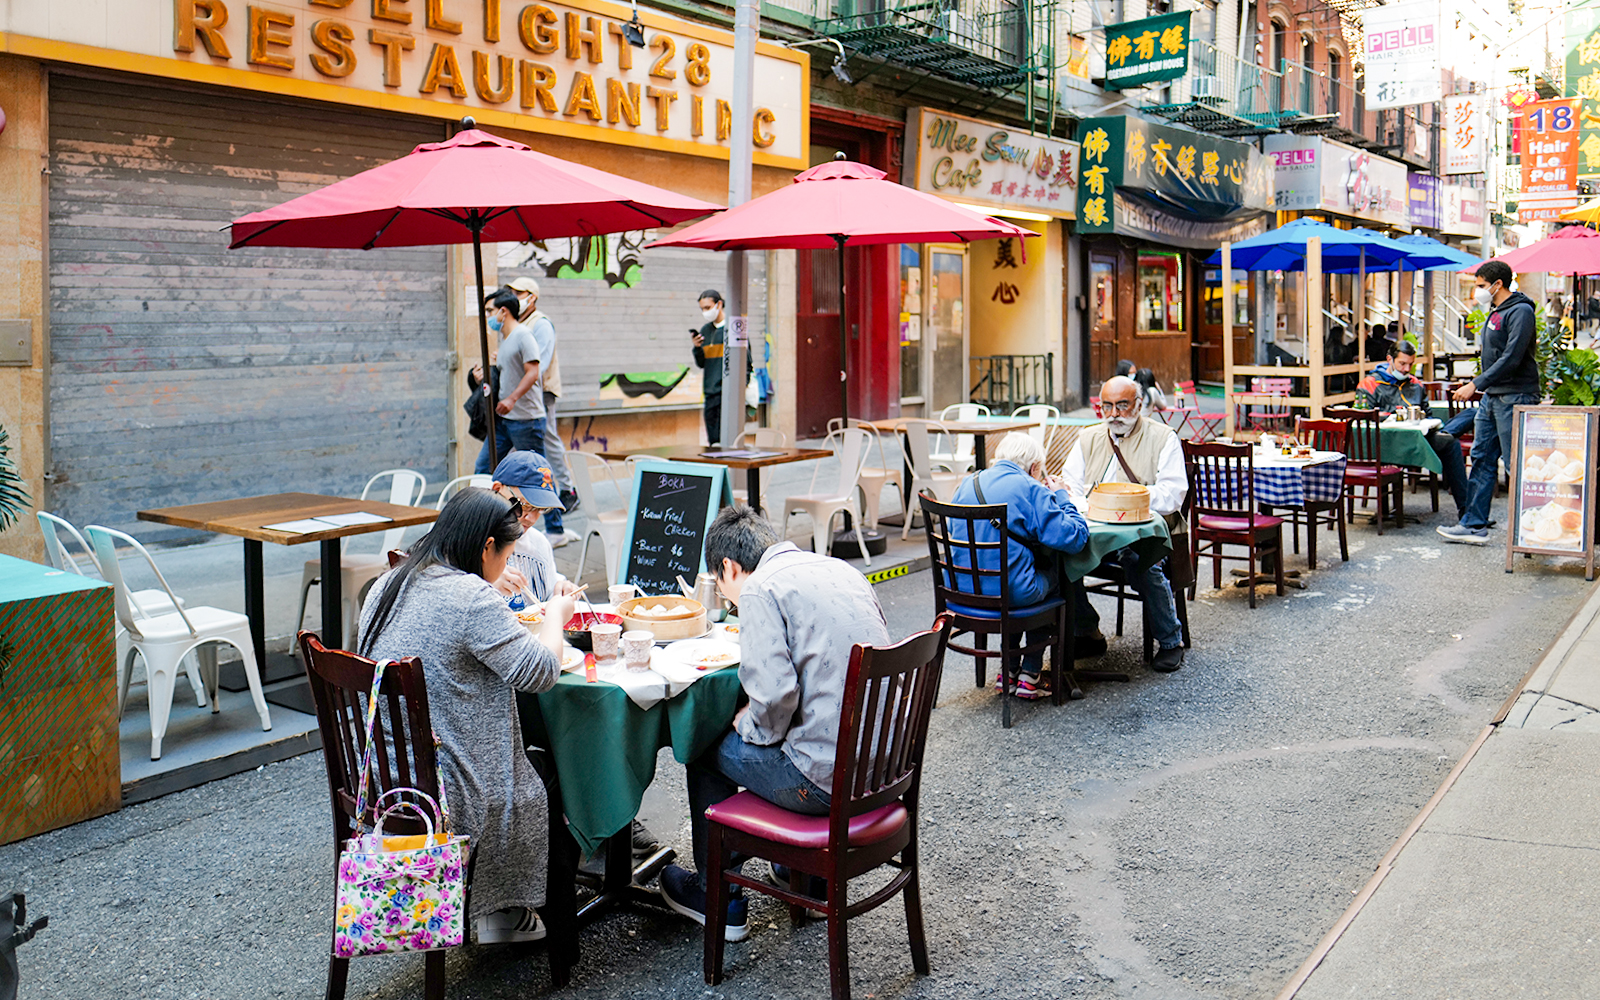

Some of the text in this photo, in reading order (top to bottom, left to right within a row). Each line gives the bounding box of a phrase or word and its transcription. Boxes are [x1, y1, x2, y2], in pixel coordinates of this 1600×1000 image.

[1368, 24, 1434, 53] PELL
[648, 33, 711, 87] 28
[1368, 45, 1435, 61] HAIR SALON
[173, 0, 679, 131] RESTAURANT
[1163, 56, 1185, 71] HOUSE
[1529, 106, 1575, 134] 18
[927, 116, 978, 153] Mee
[1528, 139, 1570, 155] Hair
[1289, 163, 1315, 172] SALON
[1536, 155, 1560, 168] Le
[931, 156, 982, 194] Cafe
[1530, 168, 1567, 182] Pell
[1121, 201, 1190, 238] VEGETARIAN
[1521, 210, 1533, 220] 18
[1534, 209, 1559, 219] PELL
[992, 237, 1020, 304] 美心
[658, 474, 685, 489] BOKA
[664, 507, 685, 524] Fried
[664, 523, 696, 537] Chicken
[638, 539, 683, 557] Beer $6
